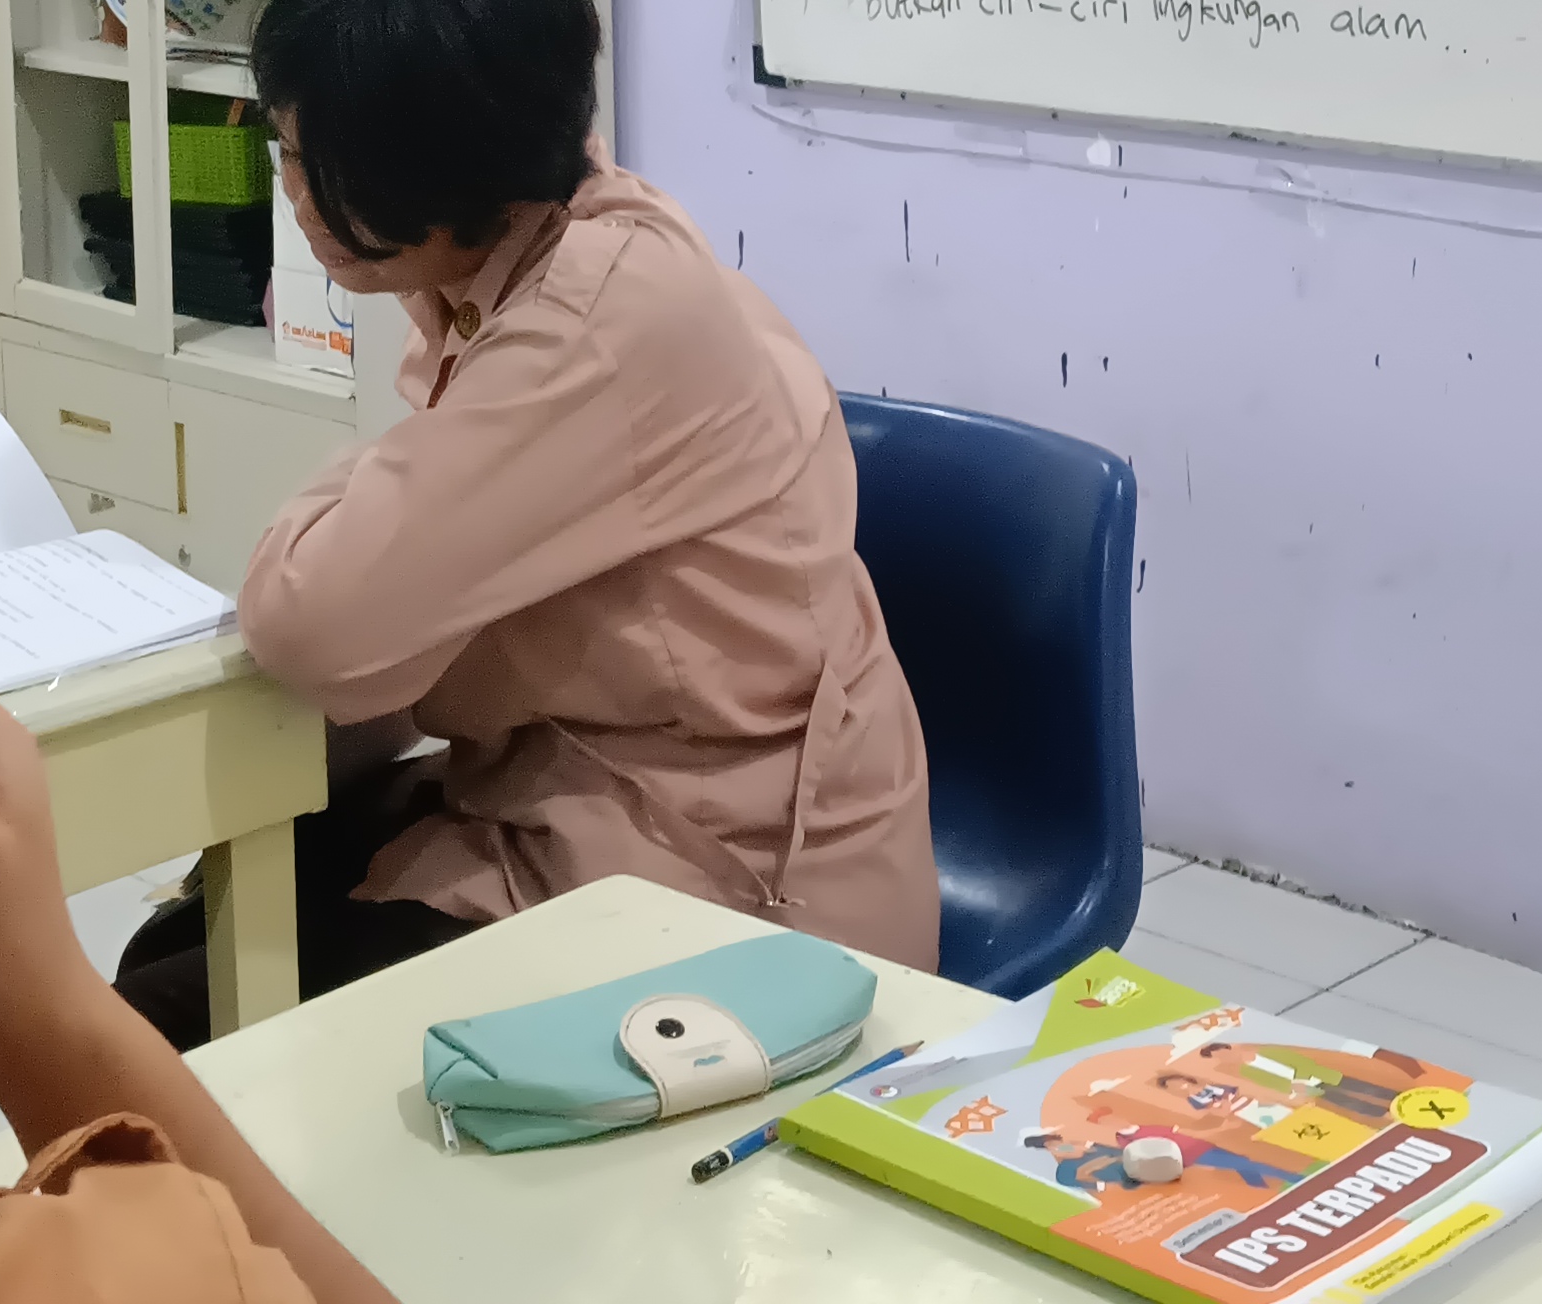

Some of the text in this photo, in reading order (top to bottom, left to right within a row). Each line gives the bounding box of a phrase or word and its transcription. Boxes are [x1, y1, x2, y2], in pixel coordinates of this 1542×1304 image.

[1330, 5, 1427, 41] alam
[1214, 1226, 1308, 1274] IPS
[1276, 1136, 1452, 1237] TERPADU
